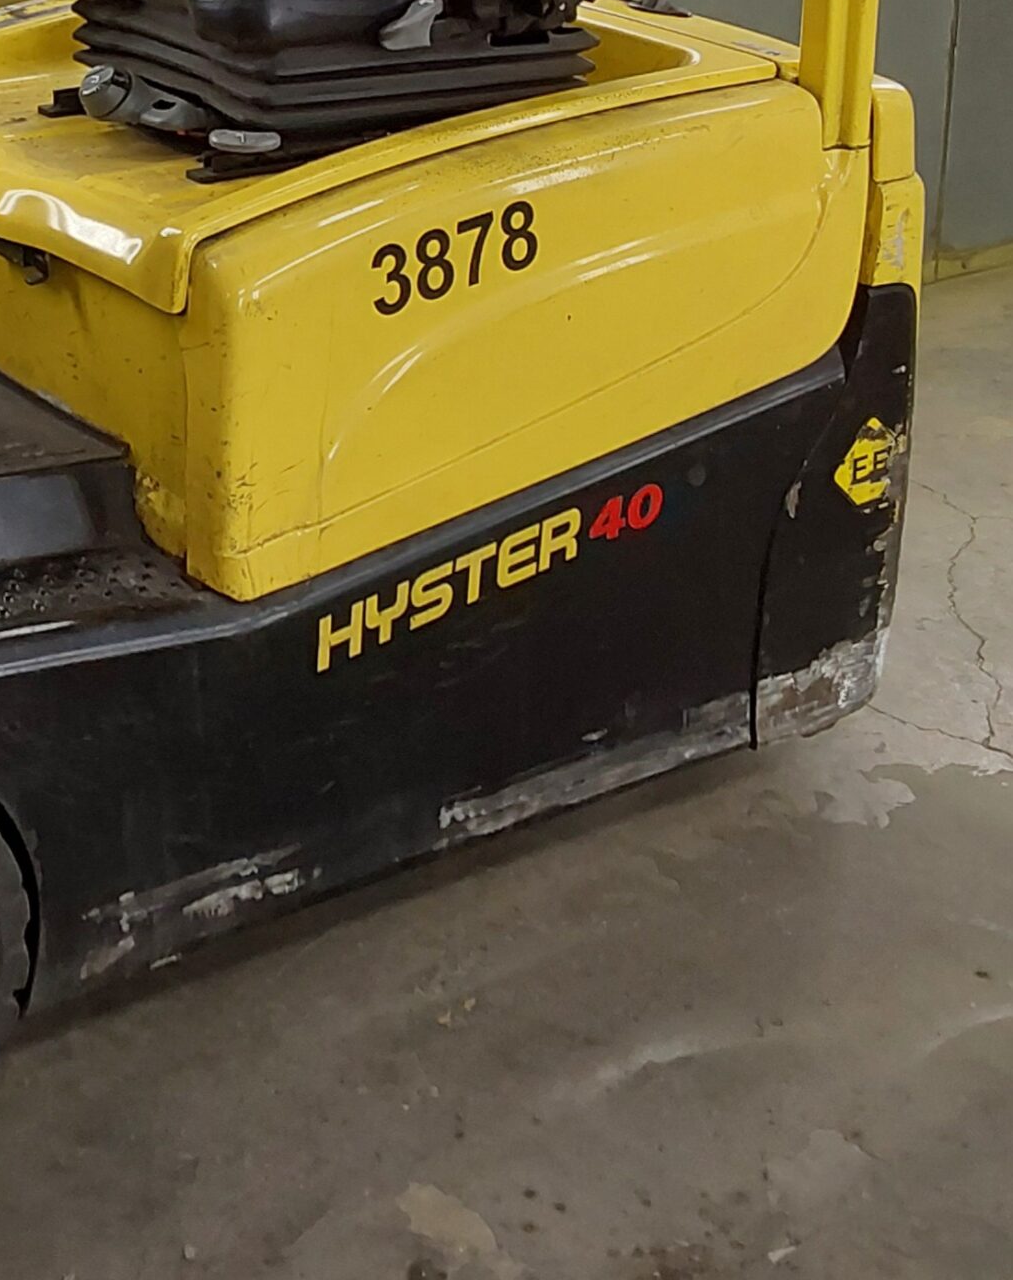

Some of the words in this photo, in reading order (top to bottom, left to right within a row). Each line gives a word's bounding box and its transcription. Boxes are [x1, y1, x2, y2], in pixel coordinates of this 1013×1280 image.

[371, 200, 538, 316] 3878
[317, 507, 582, 674] HYSTER
[588, 482, 664, 541] 40
